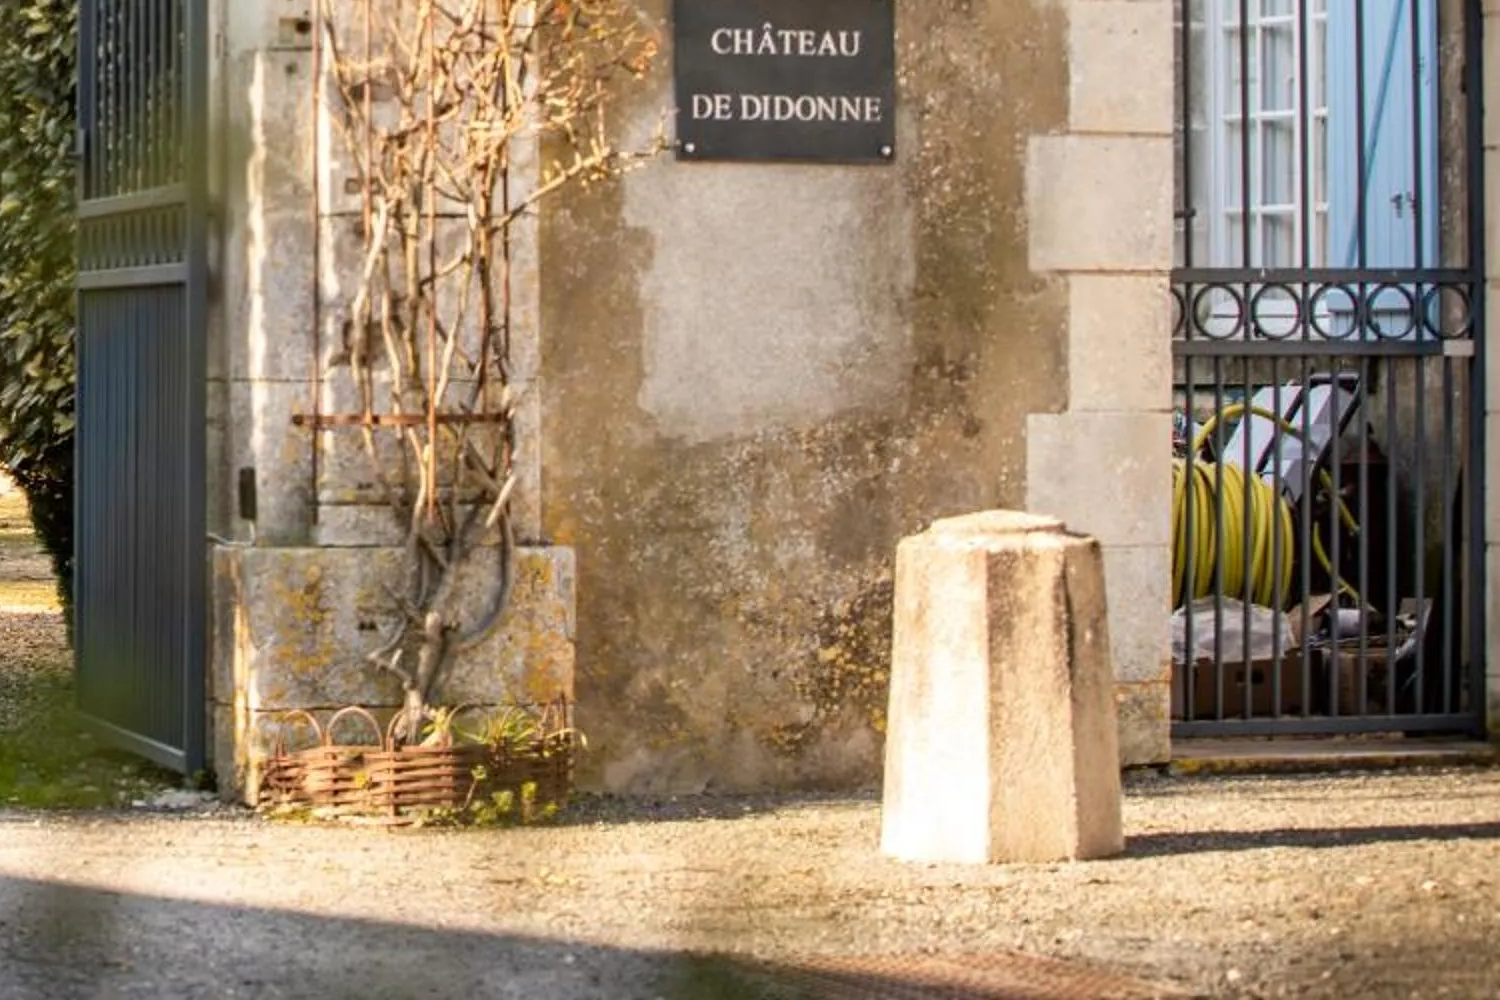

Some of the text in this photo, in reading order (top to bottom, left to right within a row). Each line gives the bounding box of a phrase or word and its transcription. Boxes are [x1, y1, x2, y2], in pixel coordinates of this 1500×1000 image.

[709, 21, 861, 56] CHÂTEAU
[691, 94, 882, 121] DE DIDONNE
